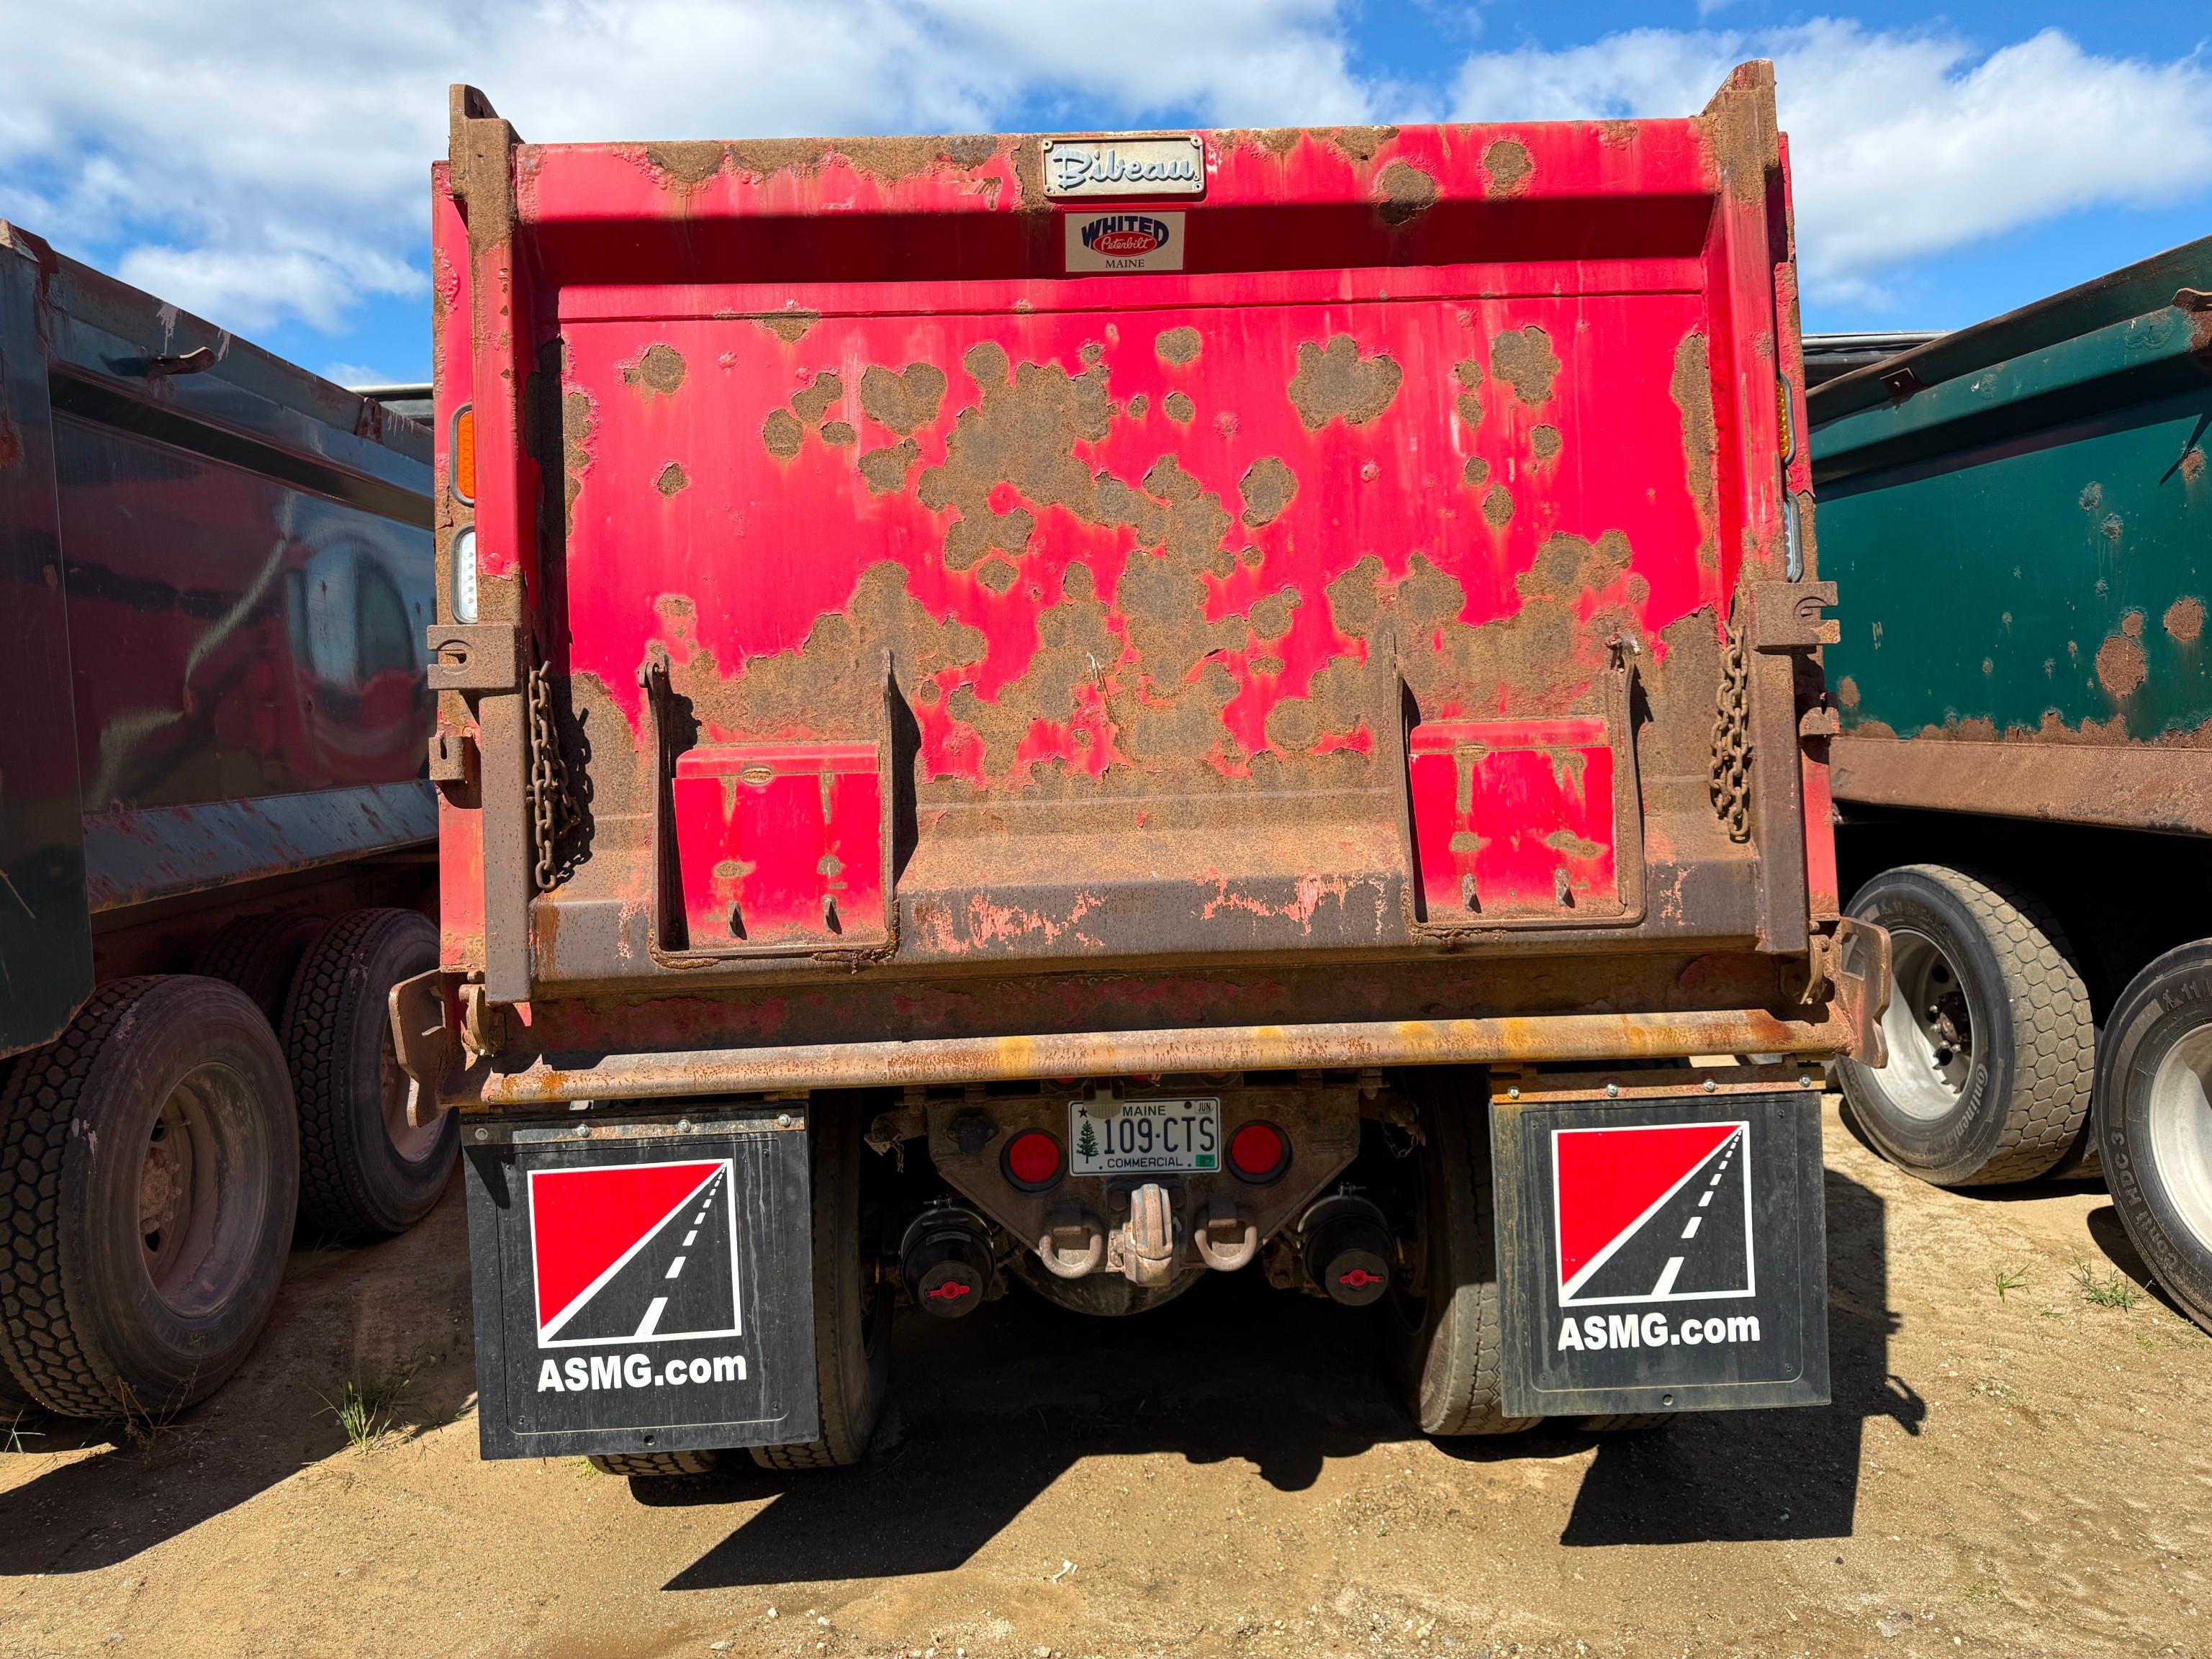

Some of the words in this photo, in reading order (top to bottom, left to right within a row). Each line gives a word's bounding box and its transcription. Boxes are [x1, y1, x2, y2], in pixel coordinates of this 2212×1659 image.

[1052, 146, 1196, 189] Bibeau
[1081, 215, 1169, 250] WHITED
[1101, 236, 1152, 251] Peterbilt
[1105, 258, 1145, 268] MAINE
[1122, 1105, 1167, 1117] MAINE
[1198, 1102, 1211, 1112] JUN
[2111, 1131, 2125, 1147] 3
[1107, 1157, 1184, 1168] COMMERCIAL
[2114, 1152, 2143, 1208] HDC
[1558, 1312, 1761, 1351] ASMG.com
[537, 1353, 747, 1392] ASMG.com
